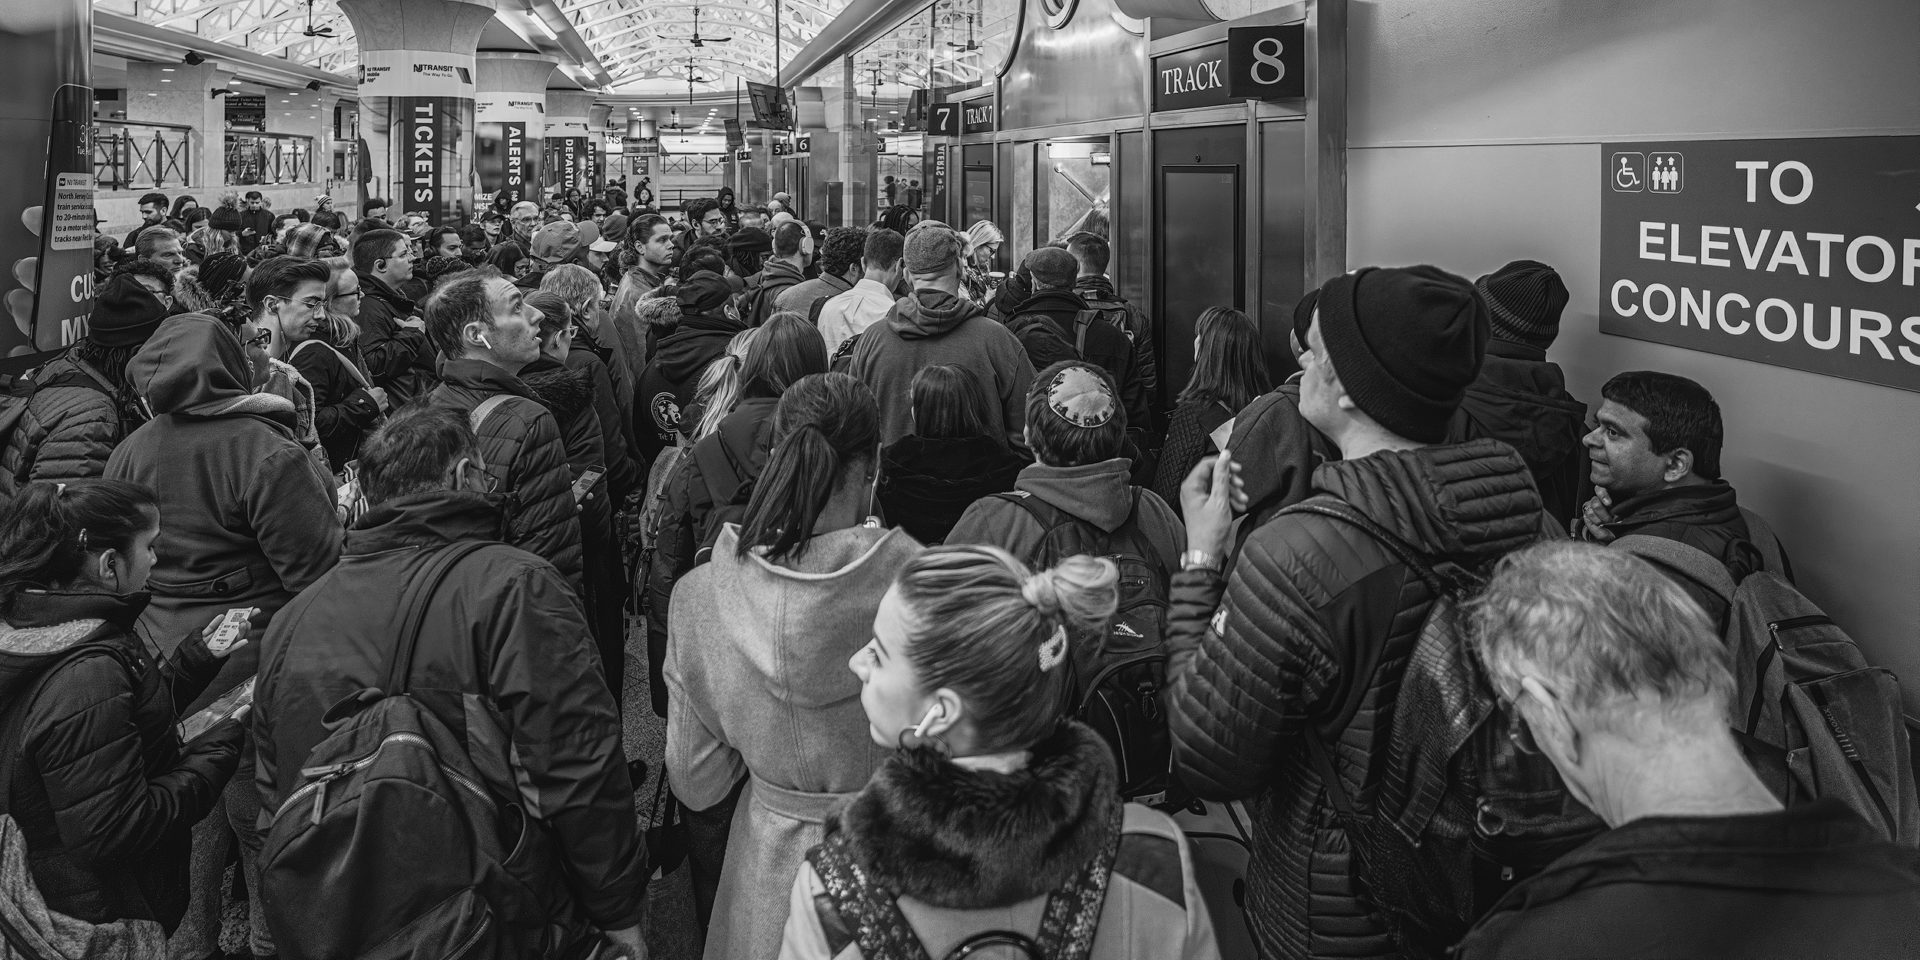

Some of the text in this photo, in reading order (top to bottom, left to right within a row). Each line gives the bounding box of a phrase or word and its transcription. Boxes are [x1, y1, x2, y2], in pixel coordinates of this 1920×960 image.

[1250, 37, 1286, 85] 8
[1161, 59, 1223, 95] TRACK
[936, 107, 951, 131] 7
[966, 105, 993, 125] TRACK 7
[414, 102, 434, 203] TICKETS
[508, 126, 521, 186] ALERTS
[774, 144, 781, 154] 5
[799, 138, 808, 151] 6
[565, 138, 574, 191] DEPARTU
[1735, 160, 1814, 205] TO
[57, 203, 71, 211] train
[58, 192, 74, 200] North
[54, 234, 74, 243] tracks
